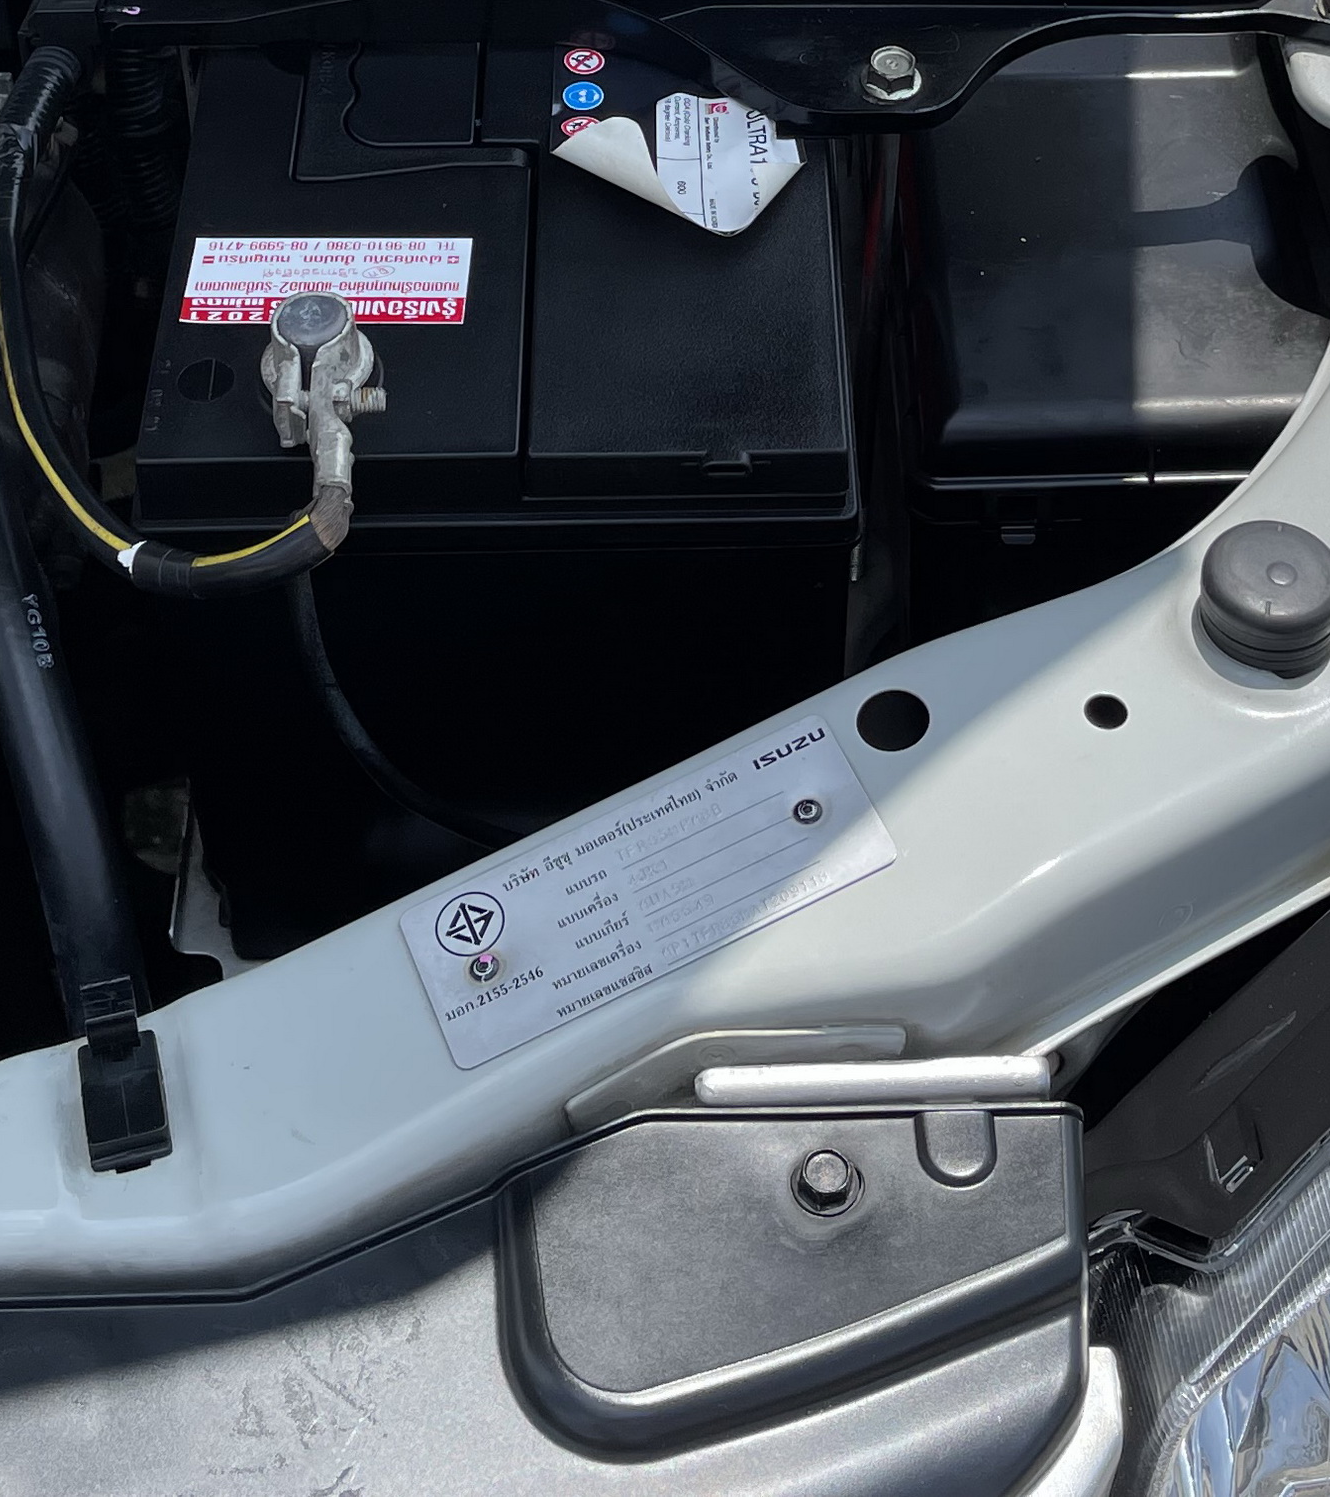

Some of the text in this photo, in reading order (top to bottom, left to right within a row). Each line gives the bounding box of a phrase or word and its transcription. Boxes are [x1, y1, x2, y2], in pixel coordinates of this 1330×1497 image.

[682, 97, 692, 147] CCA (Cold Cranking
[676, 180, 687, 195] 600
[188, 310, 265, 322] 2021
[20, 592, 55, 670] YG10B
[752, 727, 826, 771] ISUZU
[501, 769, 738, 892] บริษัท อีซูซุ มอเตอร์(ประเทศไทย) จำกัด
[564, 867, 608, 897] แบบรถ
[556, 890, 620, 929] แบบเครื่อง
[574, 911, 631, 951] แบบเกียร์
[552, 938, 643, 991] หมายเลขเครื่อง
[444, 966, 545, 1022] มอก.2155-2546
[556, 964, 654, 1019] หมายเลขแชสซิส
